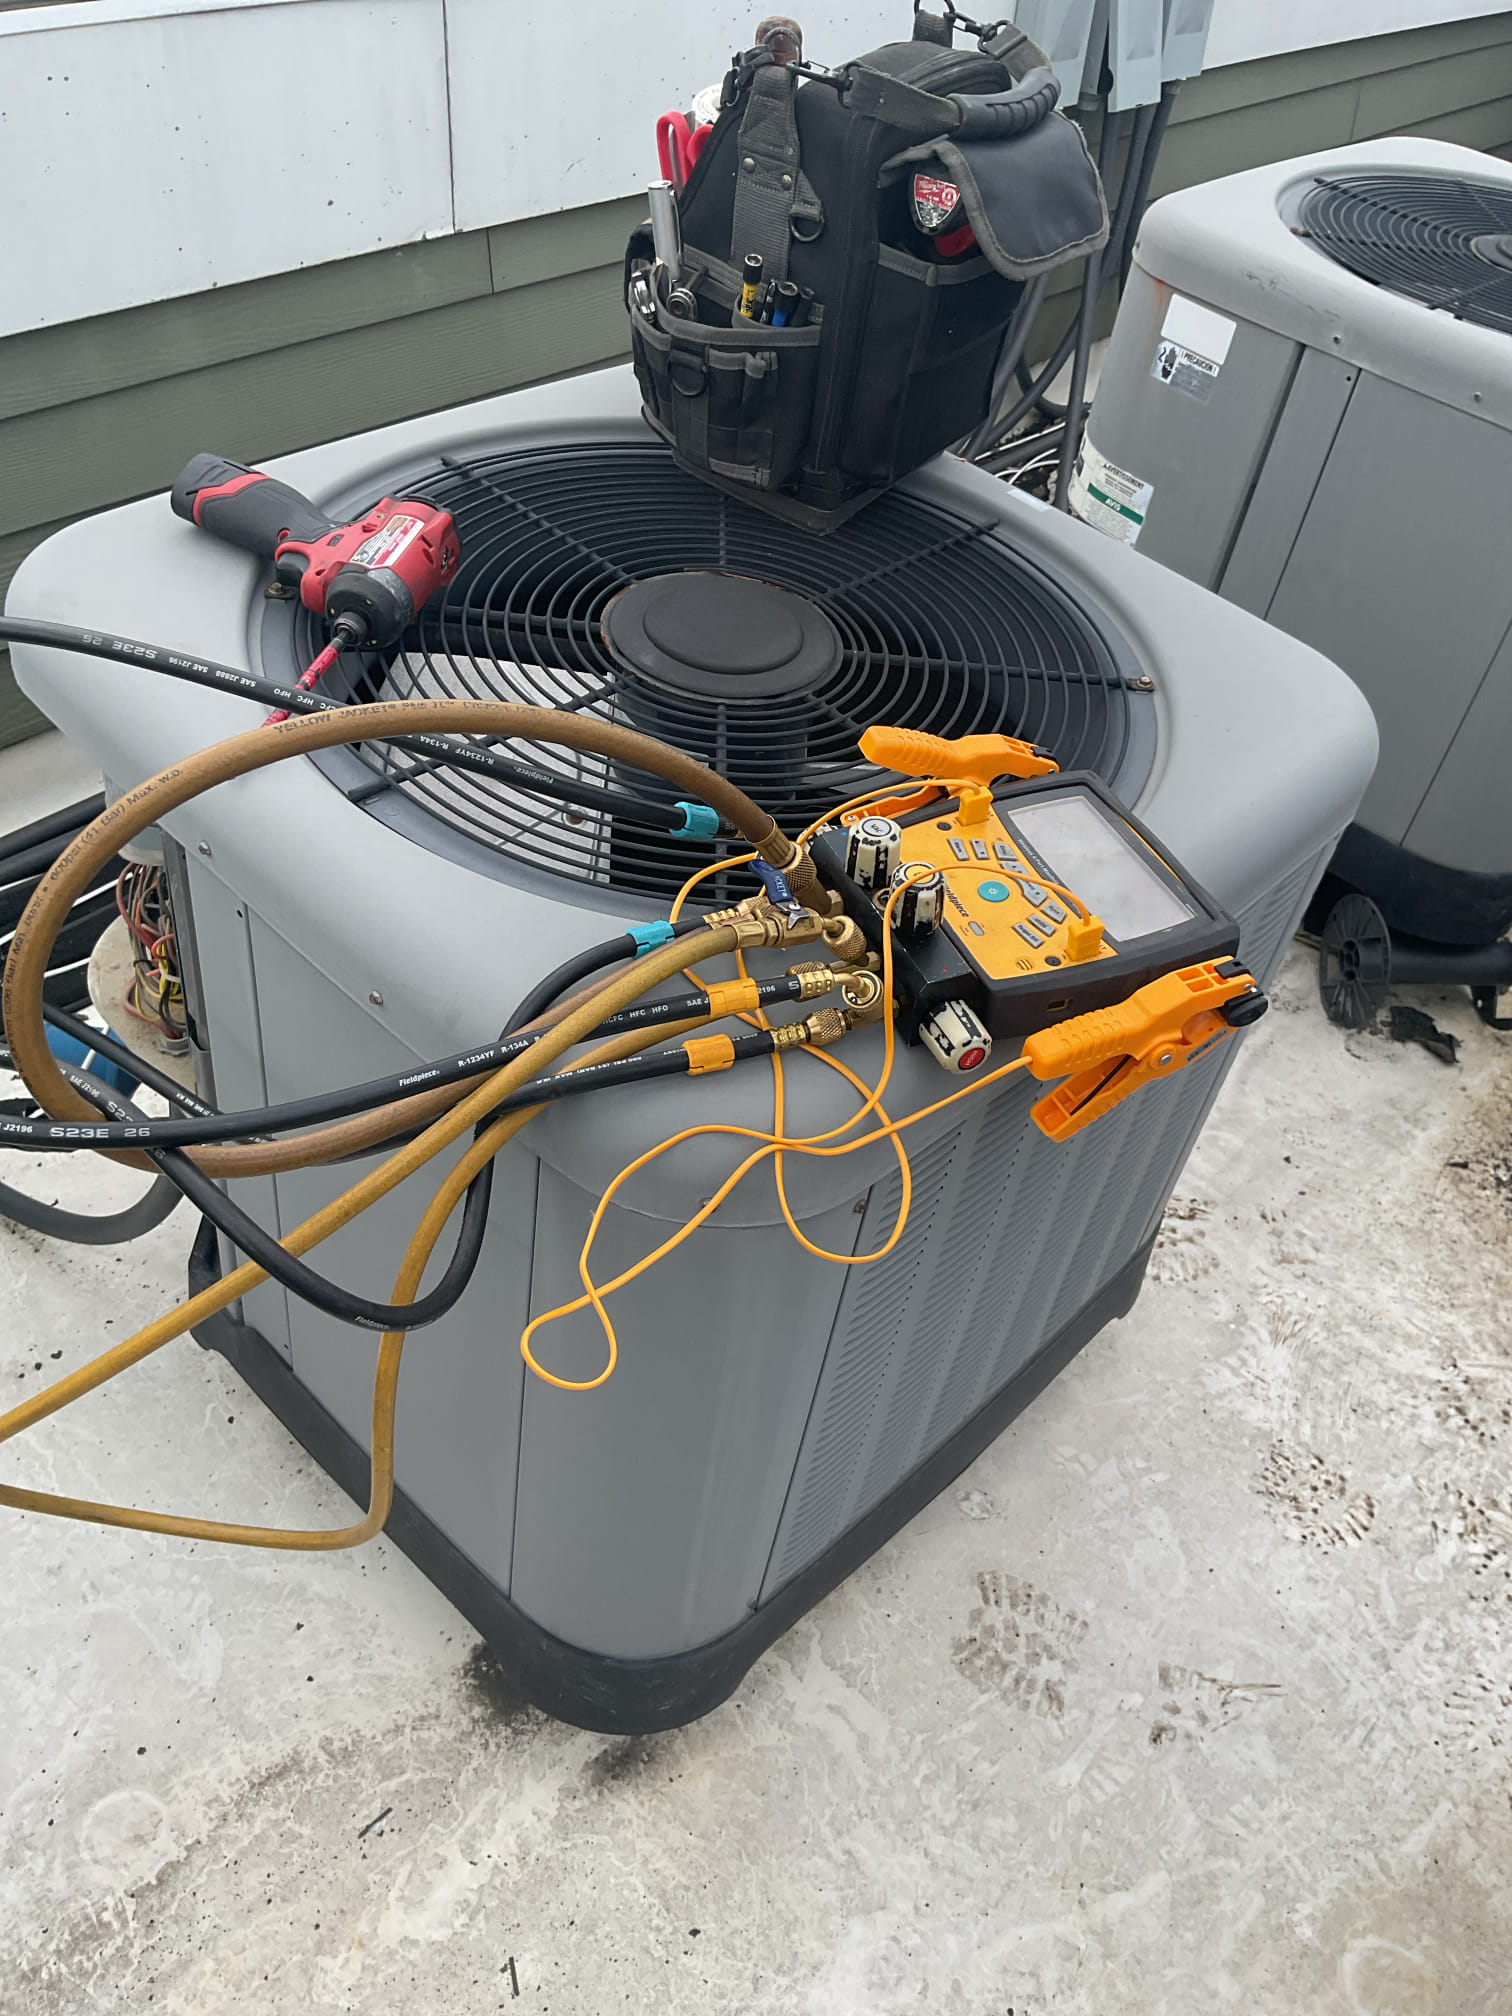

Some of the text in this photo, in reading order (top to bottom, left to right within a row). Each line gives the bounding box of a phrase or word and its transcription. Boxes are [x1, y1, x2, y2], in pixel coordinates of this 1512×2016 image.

[1104, 498, 1121, 511] AVIS
[111, 640, 158, 660] S23E
[193, 663, 208, 673] SAE
[240, 676, 256, 688] SAE
[273, 687, 292, 699] HFO
[296, 694, 314, 706] HFC
[272, 713, 332, 735] YELLOW
[419, 735, 449, 751] R-134A
[455, 748, 495, 765] R-1234YF
[101, 803, 126, 826] Bar)
[629, 1009, 647, 1018] HFC
[651, 1004, 669, 1014] HFO
[686, 998, 703, 1007] SAE
[457, 1049, 495, 1067] R-1234YF
[500, 1039, 530, 1054] R-134A
[69, 1074, 83, 1087] SAE
[3, 1123, 151, 1139] J2196 S23E 26
